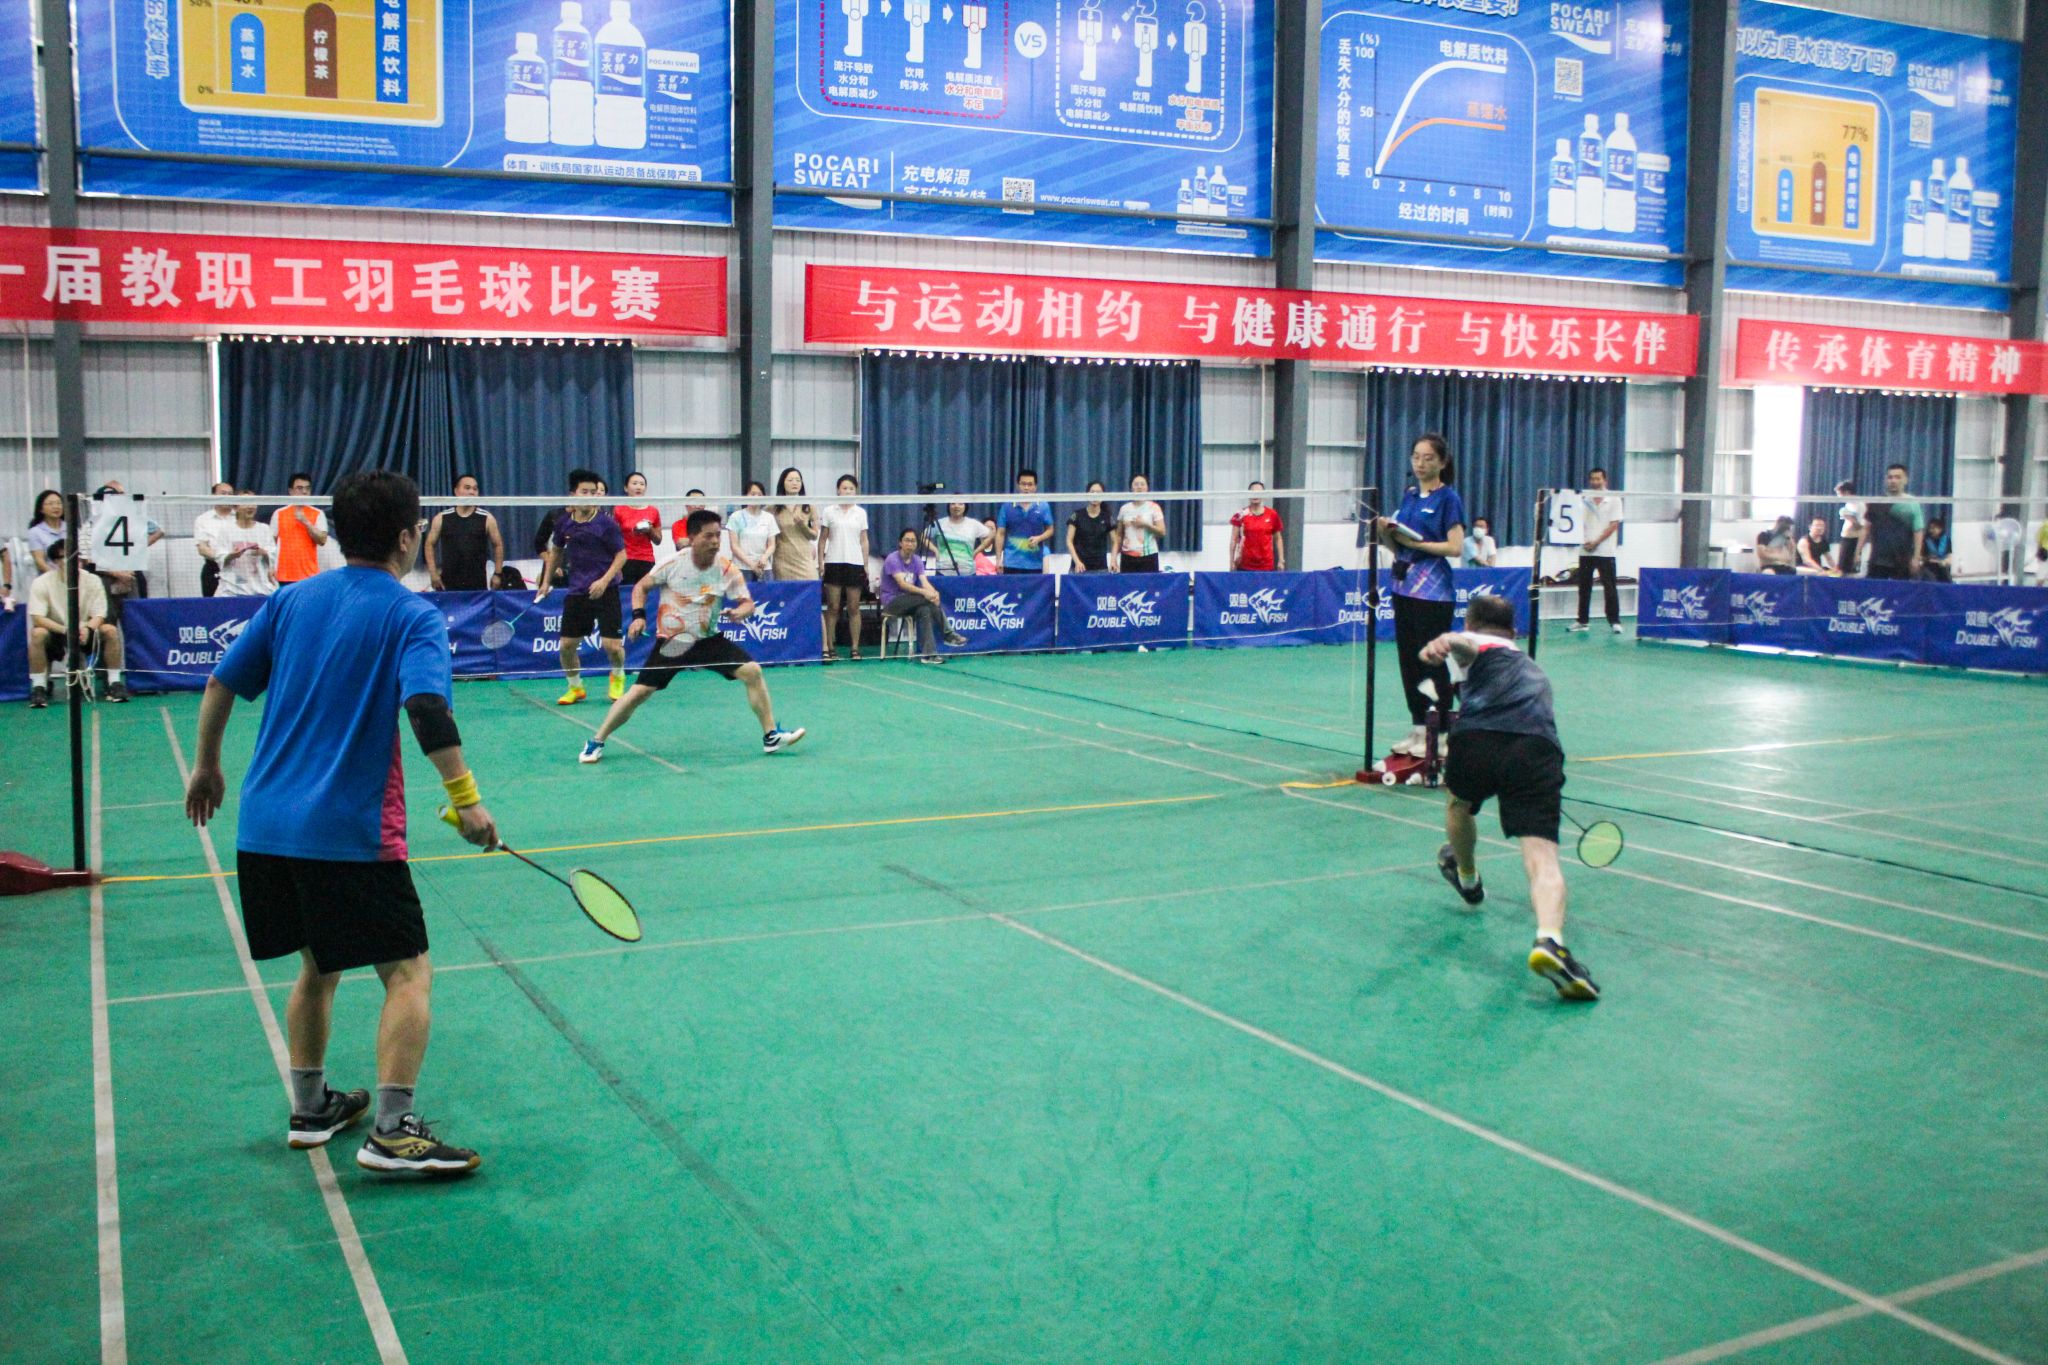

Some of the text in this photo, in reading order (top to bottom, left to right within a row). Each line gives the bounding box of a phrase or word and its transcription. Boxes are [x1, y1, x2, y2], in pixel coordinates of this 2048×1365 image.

[1550, 3, 1610, 25] POCARI
[1550, 17, 1604, 36] SWEAT
[1020, 32, 1042, 48] VS
[1359, 32, 1380, 47] (%)
[601, 51, 639, 65] 宝矿力
[1354, 46, 1375, 60] 100
[1439, 39, 1508, 65] 电解质饮料
[601, 62, 625, 74] 水特
[833, 60, 874, 74] 流汗导致
[904, 67, 924, 79] 饮用
[1907, 64, 1953, 82] POCARI
[658, 73, 689, 84] 宝矿力
[838, 74, 869, 86] 水分和
[900, 79, 929, 92] 纯净水
[1907, 76, 1949, 91] SWEAT
[828, 86, 878, 99] 电解质减少
[1336, 38, 1352, 178] 丢失水分的恢复率
[1359, 106, 1374, 118] 50
[1842, 125, 1869, 142] 77%
[794, 153, 879, 174] POCARI
[794, 169, 871, 189] SWEAT
[902, 165, 971, 186] 充电解渴
[1365, 167, 1373, 178] 0
[1372, 179, 1512, 203] 0 2 4 6 8 10
[1040, 194, 1120, 207] www.pocarisweat.cn
[1398, 202, 1469, 226] 经过的时间
[851, 280, 1667, 366] 与运动相约 与健康通行 与快乐长伴
[1765, 329, 2021, 385] 传承体育精神
[1558, 504, 1575, 533] 5
[104, 515, 134, 556] 4
[954, 597, 976, 612] 双鱼
[1097, 596, 1117, 611] 双鱼
[1229, 593, 1248, 607] 双鱼
[1220, 612, 1288, 624] DOUBLE FISH
[1656, 605, 1684, 619] DOUBLE
[947, 616, 1025, 630] DOUBLE FISH
[1087, 615, 1161, 628] DOUBLE FISH
[1828, 617, 1899, 635] DOUBLE FISH
[178, 625, 208, 644] 双鱼
[761, 627, 788, 641] FISH
[1956, 630, 2038, 648] DOUBLE FISH
